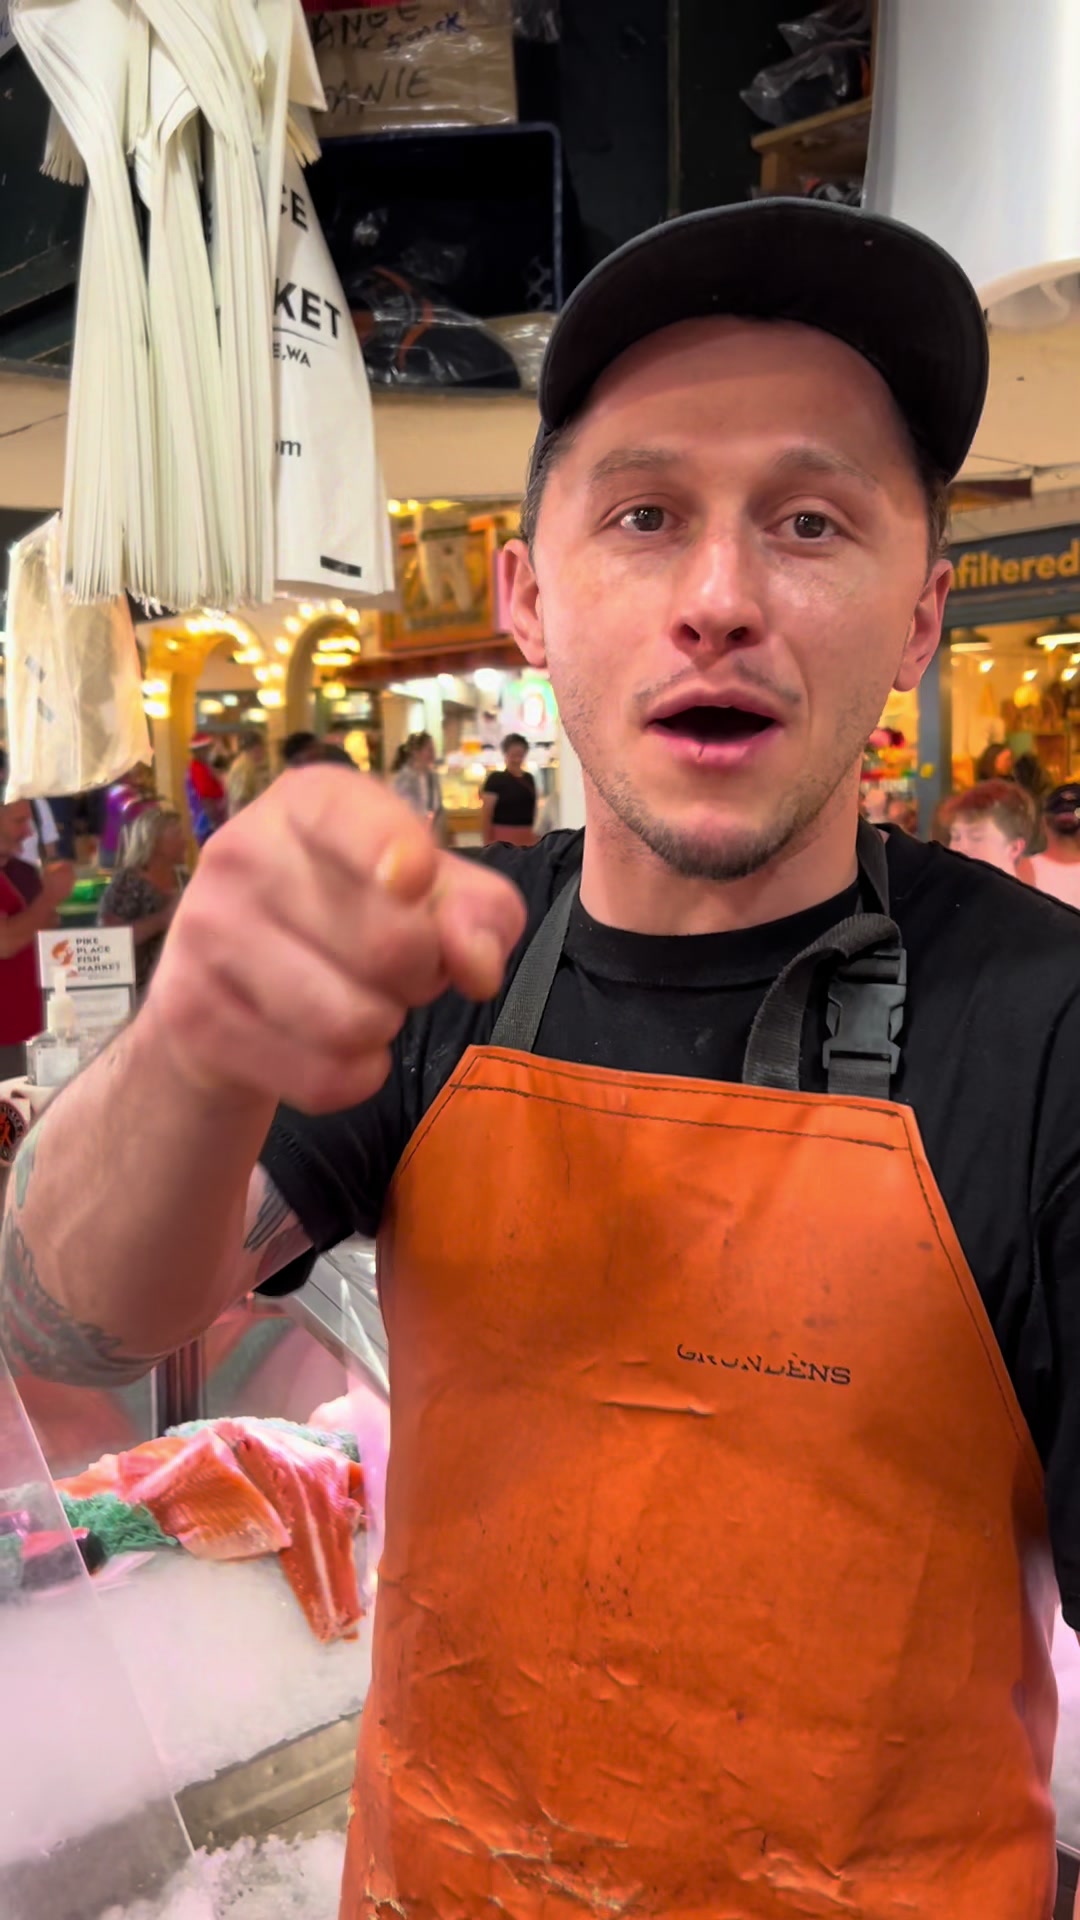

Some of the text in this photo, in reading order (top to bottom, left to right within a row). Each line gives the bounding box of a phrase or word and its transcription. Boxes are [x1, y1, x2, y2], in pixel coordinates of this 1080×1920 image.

[76, 937, 98, 945] PIKE
[76, 946, 111, 954] PLACE
[77, 955, 101, 963] FISH
[77, 963, 121, 972] MARKET
